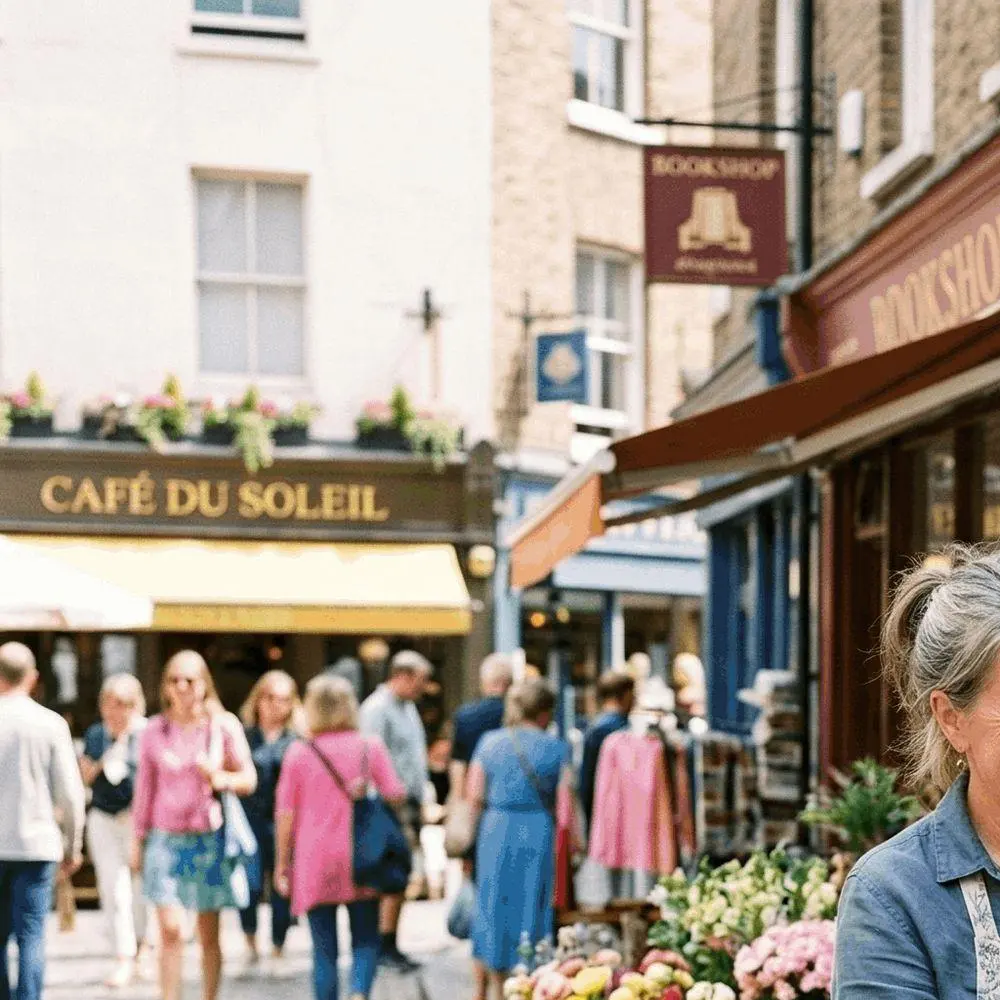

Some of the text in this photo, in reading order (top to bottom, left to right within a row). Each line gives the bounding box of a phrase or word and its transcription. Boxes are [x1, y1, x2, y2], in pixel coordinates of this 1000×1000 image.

[40, 470, 390, 521] CAFÉ DU SOLEIL
